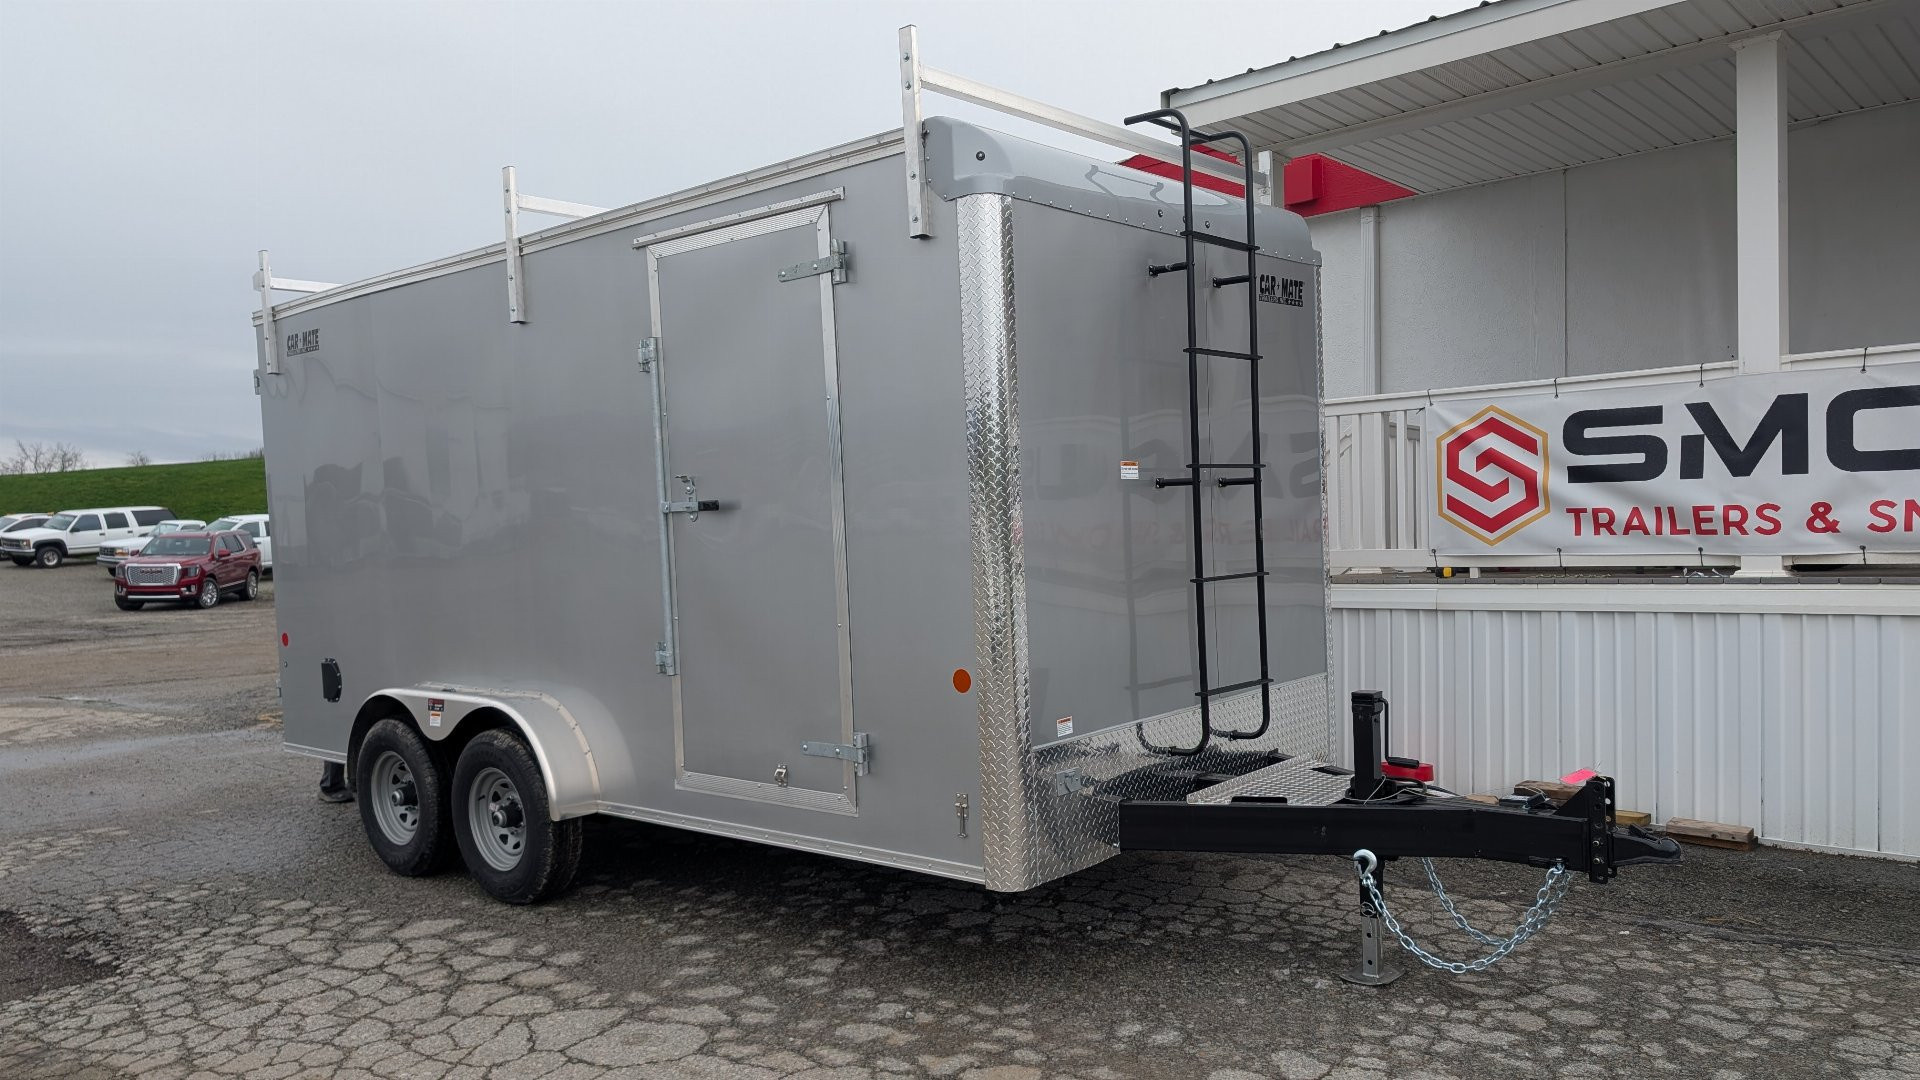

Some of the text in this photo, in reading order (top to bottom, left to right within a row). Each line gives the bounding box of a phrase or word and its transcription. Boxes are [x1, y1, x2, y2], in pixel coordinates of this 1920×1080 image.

[1281, 278, 1303, 299] MATE
[1566, 503, 1781, 536] TRAILERS
[1806, 502, 1840, 533] &
